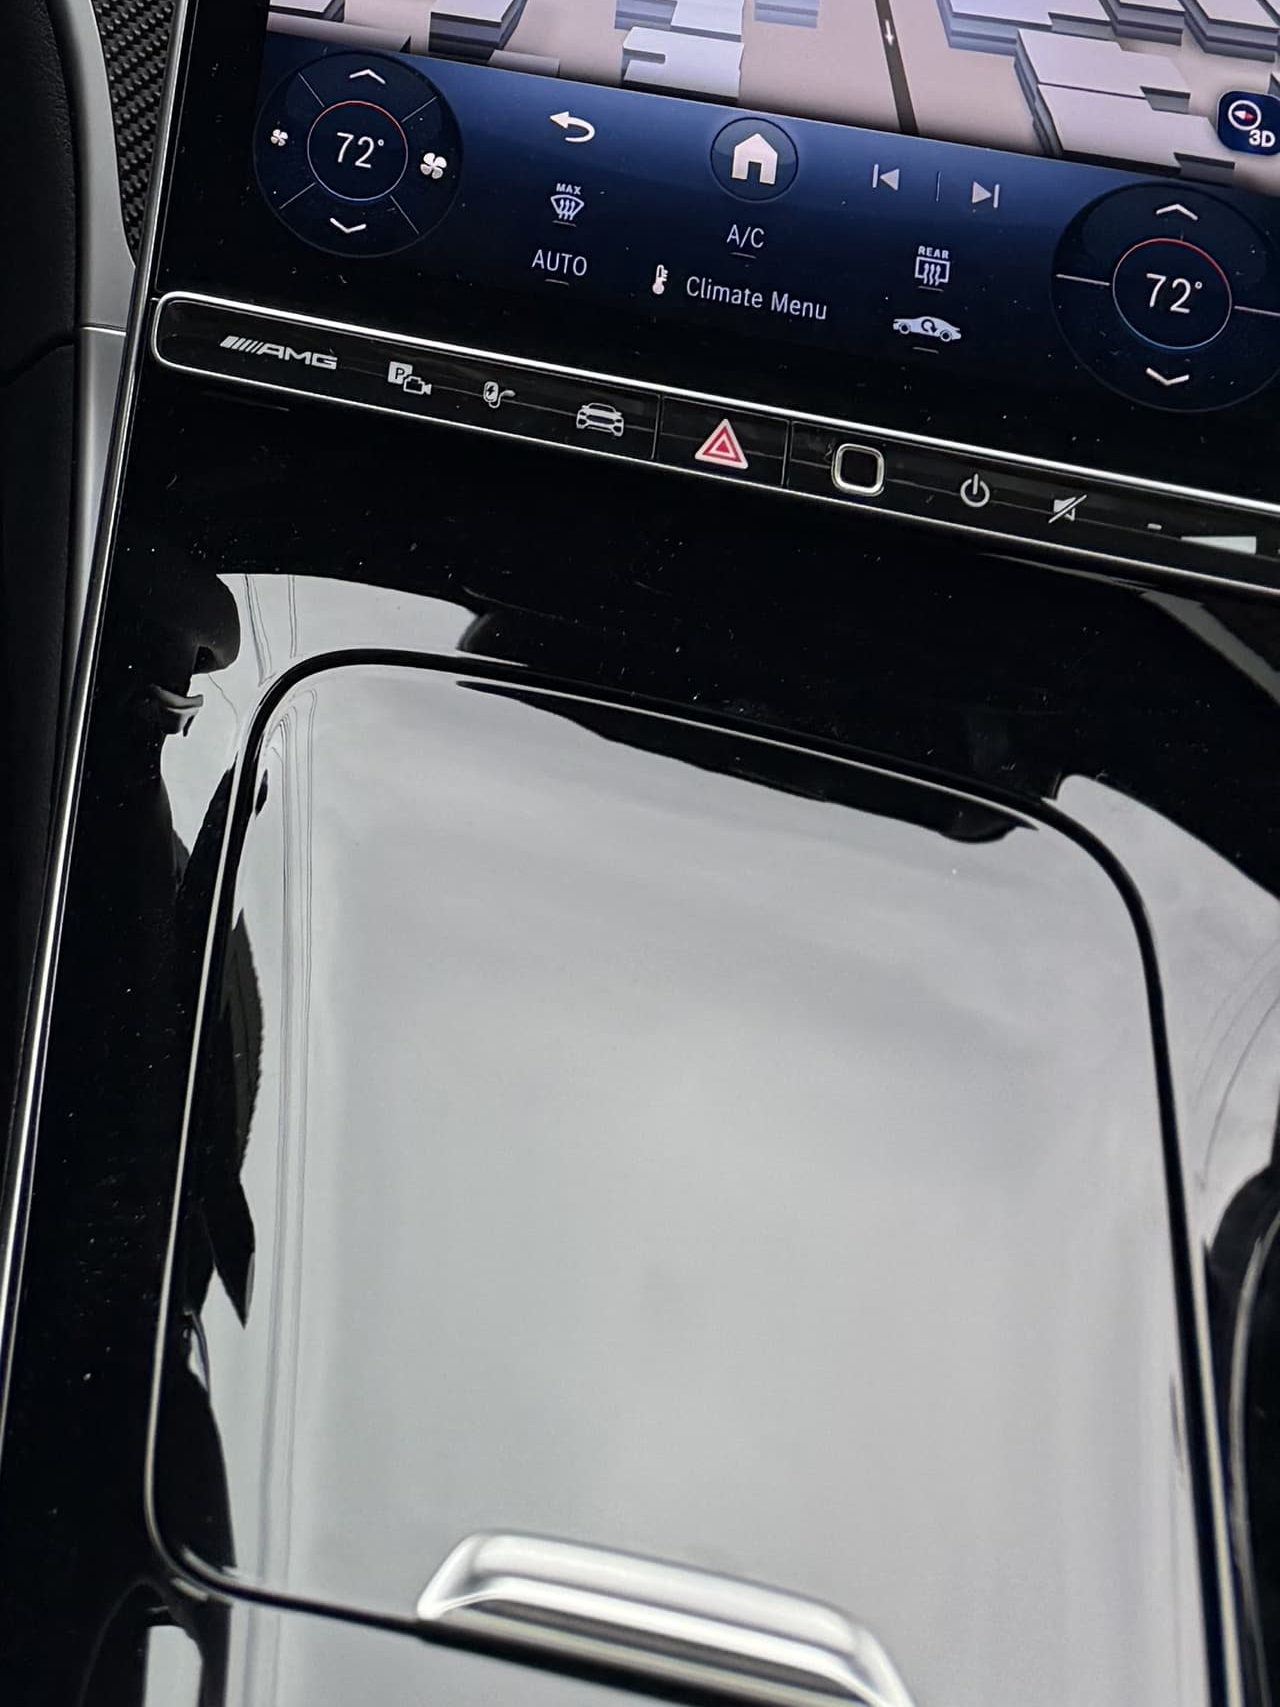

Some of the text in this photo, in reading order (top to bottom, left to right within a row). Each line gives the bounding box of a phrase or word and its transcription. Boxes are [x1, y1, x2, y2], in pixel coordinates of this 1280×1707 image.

[1249, 129, 1276, 148] 3D
[556, 183, 582, 195] MAX
[726, 224, 766, 249] A/C
[531, 249, 588, 277] AUTO
[918, 245, 950, 260] REAR
[686, 276, 828, 321] Climate Menu
[250, 341, 338, 370] AMG
